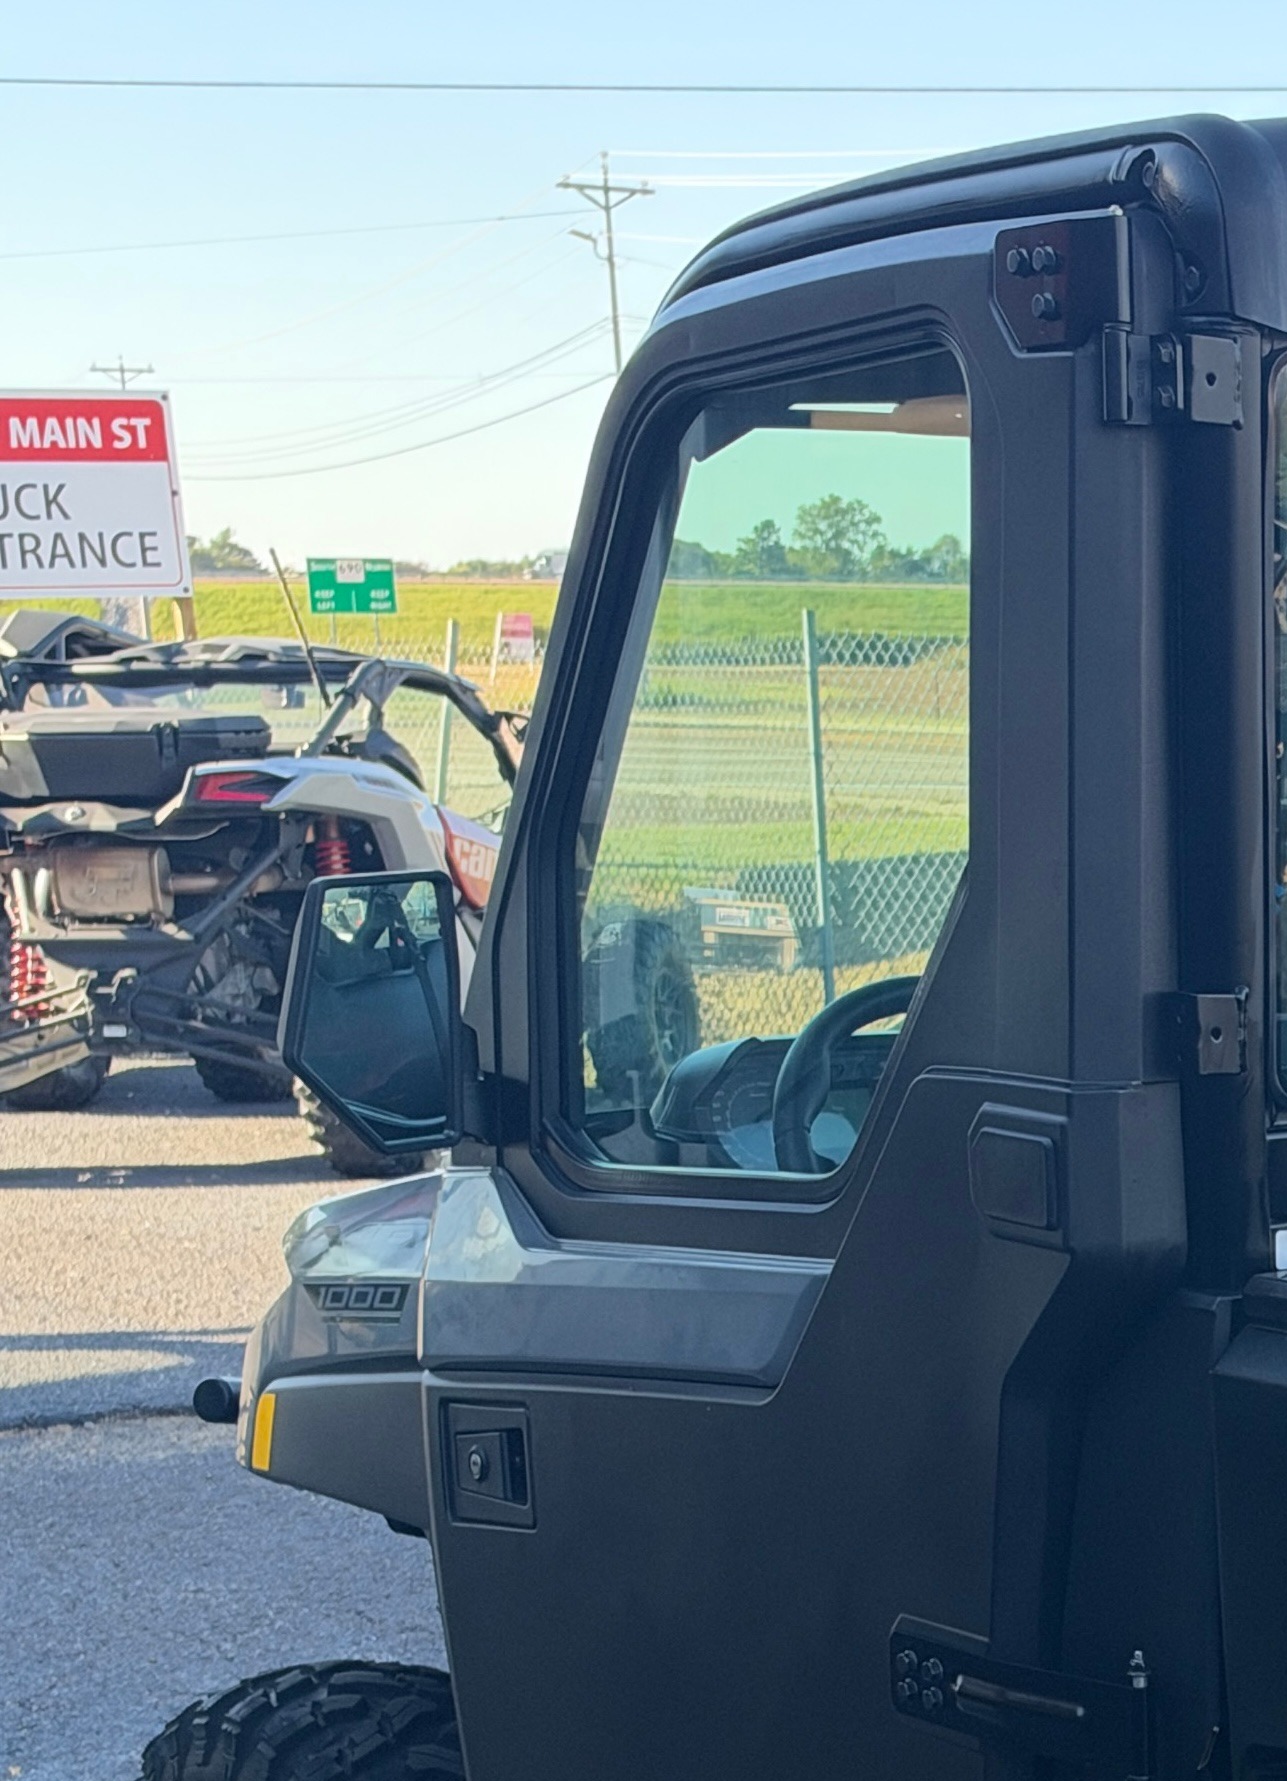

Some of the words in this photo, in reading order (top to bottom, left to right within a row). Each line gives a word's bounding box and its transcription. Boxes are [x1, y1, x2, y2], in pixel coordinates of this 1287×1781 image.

[9, 416, 103, 449] MAIN
[111, 417, 151, 449] ST
[317, 1286, 401, 1309] 1000
